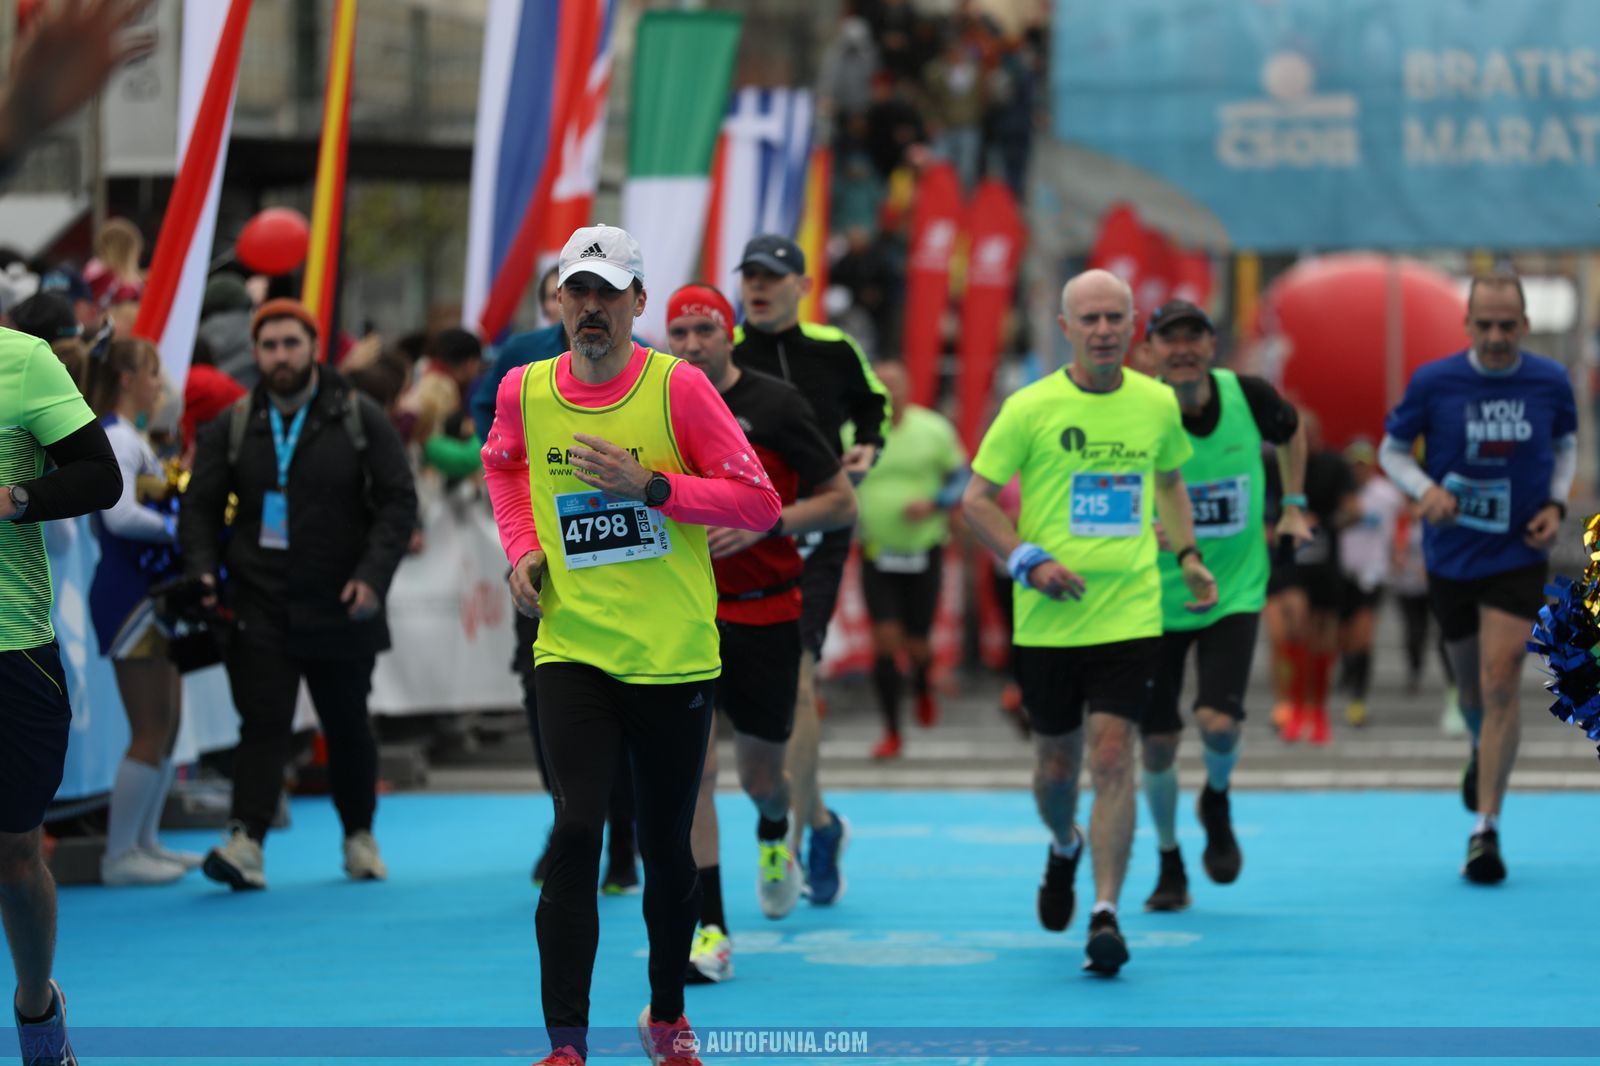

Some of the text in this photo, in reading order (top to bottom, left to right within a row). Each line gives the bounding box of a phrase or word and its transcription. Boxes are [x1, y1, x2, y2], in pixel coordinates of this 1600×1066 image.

[1481, 400, 1525, 420] YOU
[1466, 421, 1533, 441] NEED
[1073, 494, 1109, 516] 215
[565, 513, 629, 544] 4798
